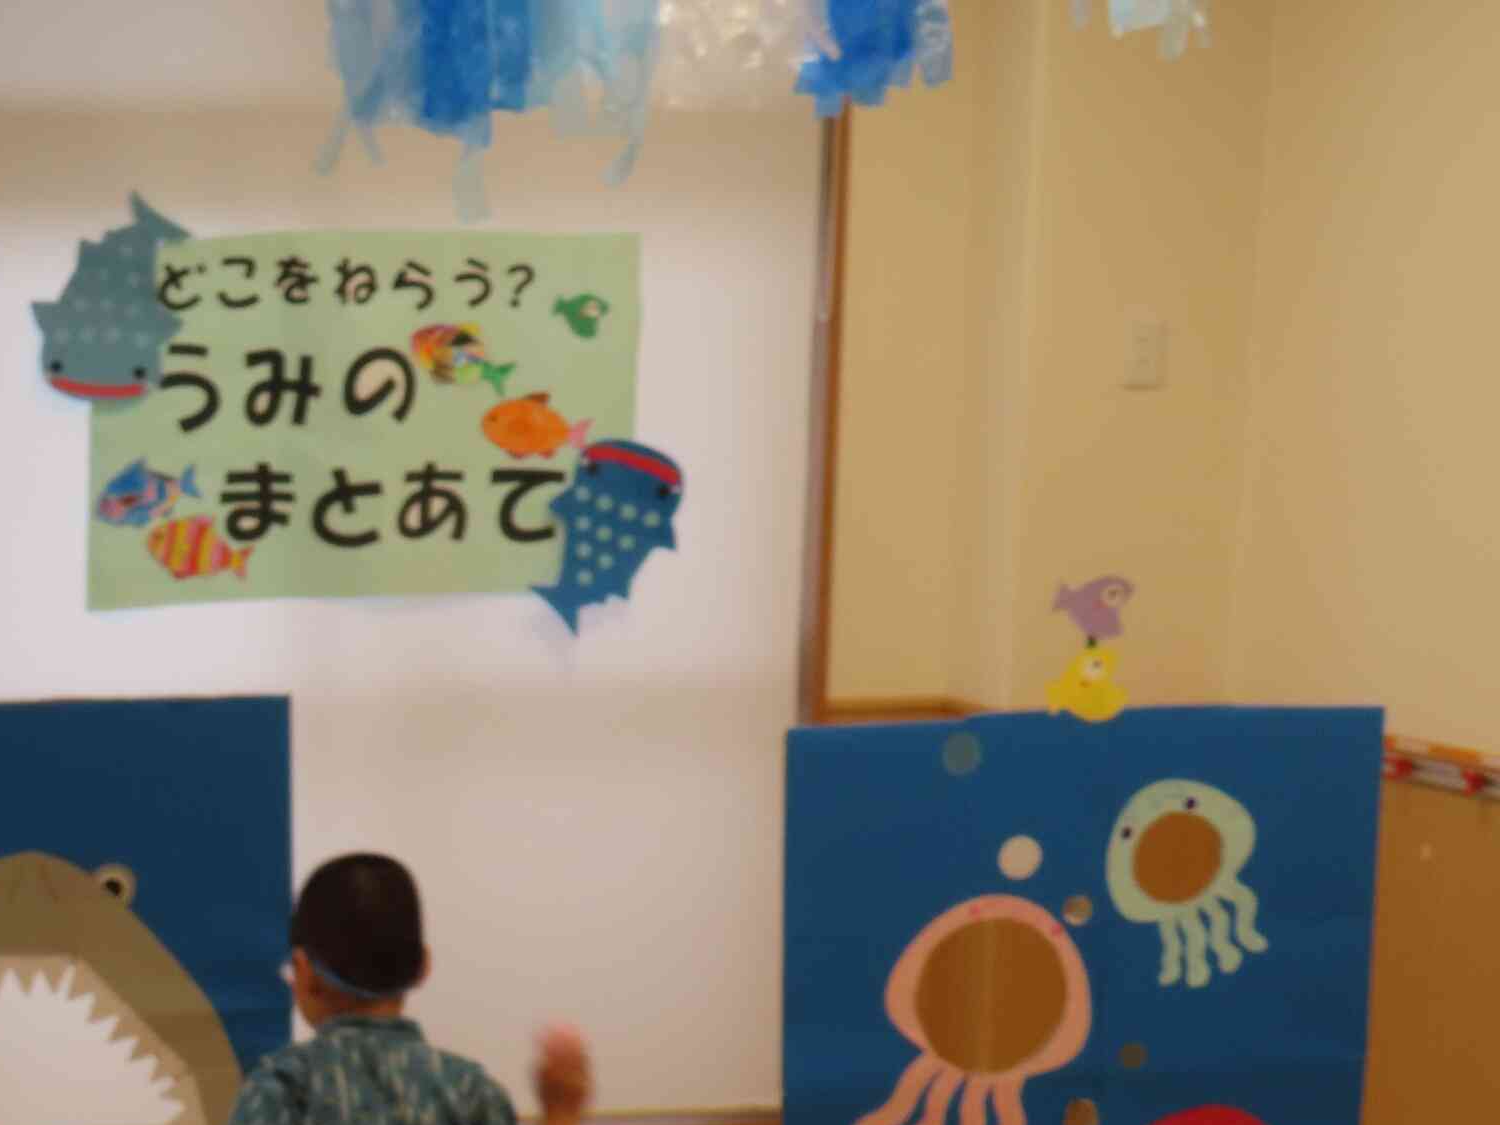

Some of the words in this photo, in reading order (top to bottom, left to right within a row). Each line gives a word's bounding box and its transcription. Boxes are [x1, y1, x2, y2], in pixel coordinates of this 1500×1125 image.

[156, 256, 536, 312] どこをねらう?
[160, 343, 417, 433] うみの
[219, 462, 565, 548] まとあて
